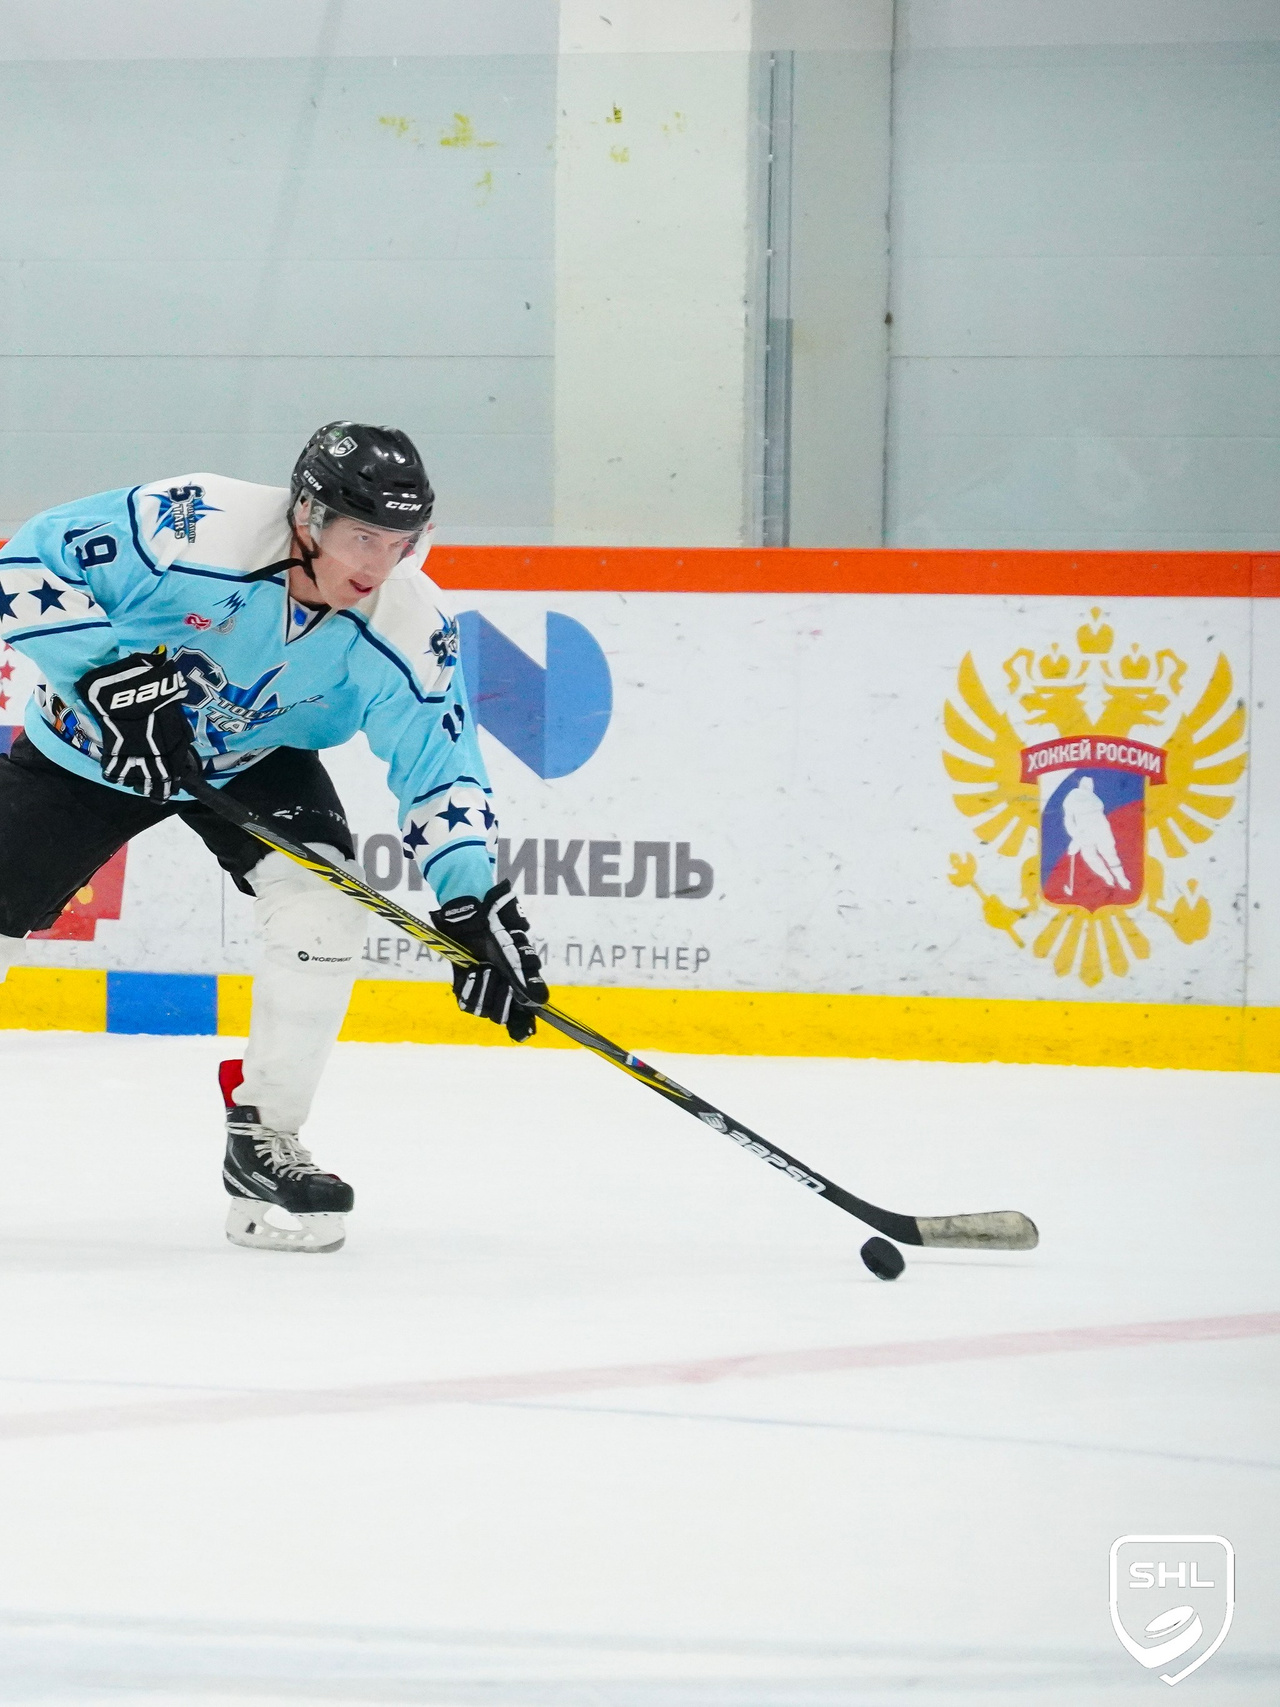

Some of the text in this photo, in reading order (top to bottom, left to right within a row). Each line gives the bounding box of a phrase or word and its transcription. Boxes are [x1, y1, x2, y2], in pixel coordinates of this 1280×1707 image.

[302, 469, 323, 492] CCM
[384, 500, 423, 512] CCM
[63, 520, 117, 571] 19
[110, 670, 188, 711] BAU
[1027, 739, 1161, 774] ХОККЕЙ РОССИИ
[352, 833, 714, 900] ОИКЕЛЬ
[565, 943, 712, 973] ПАРТНЕР
